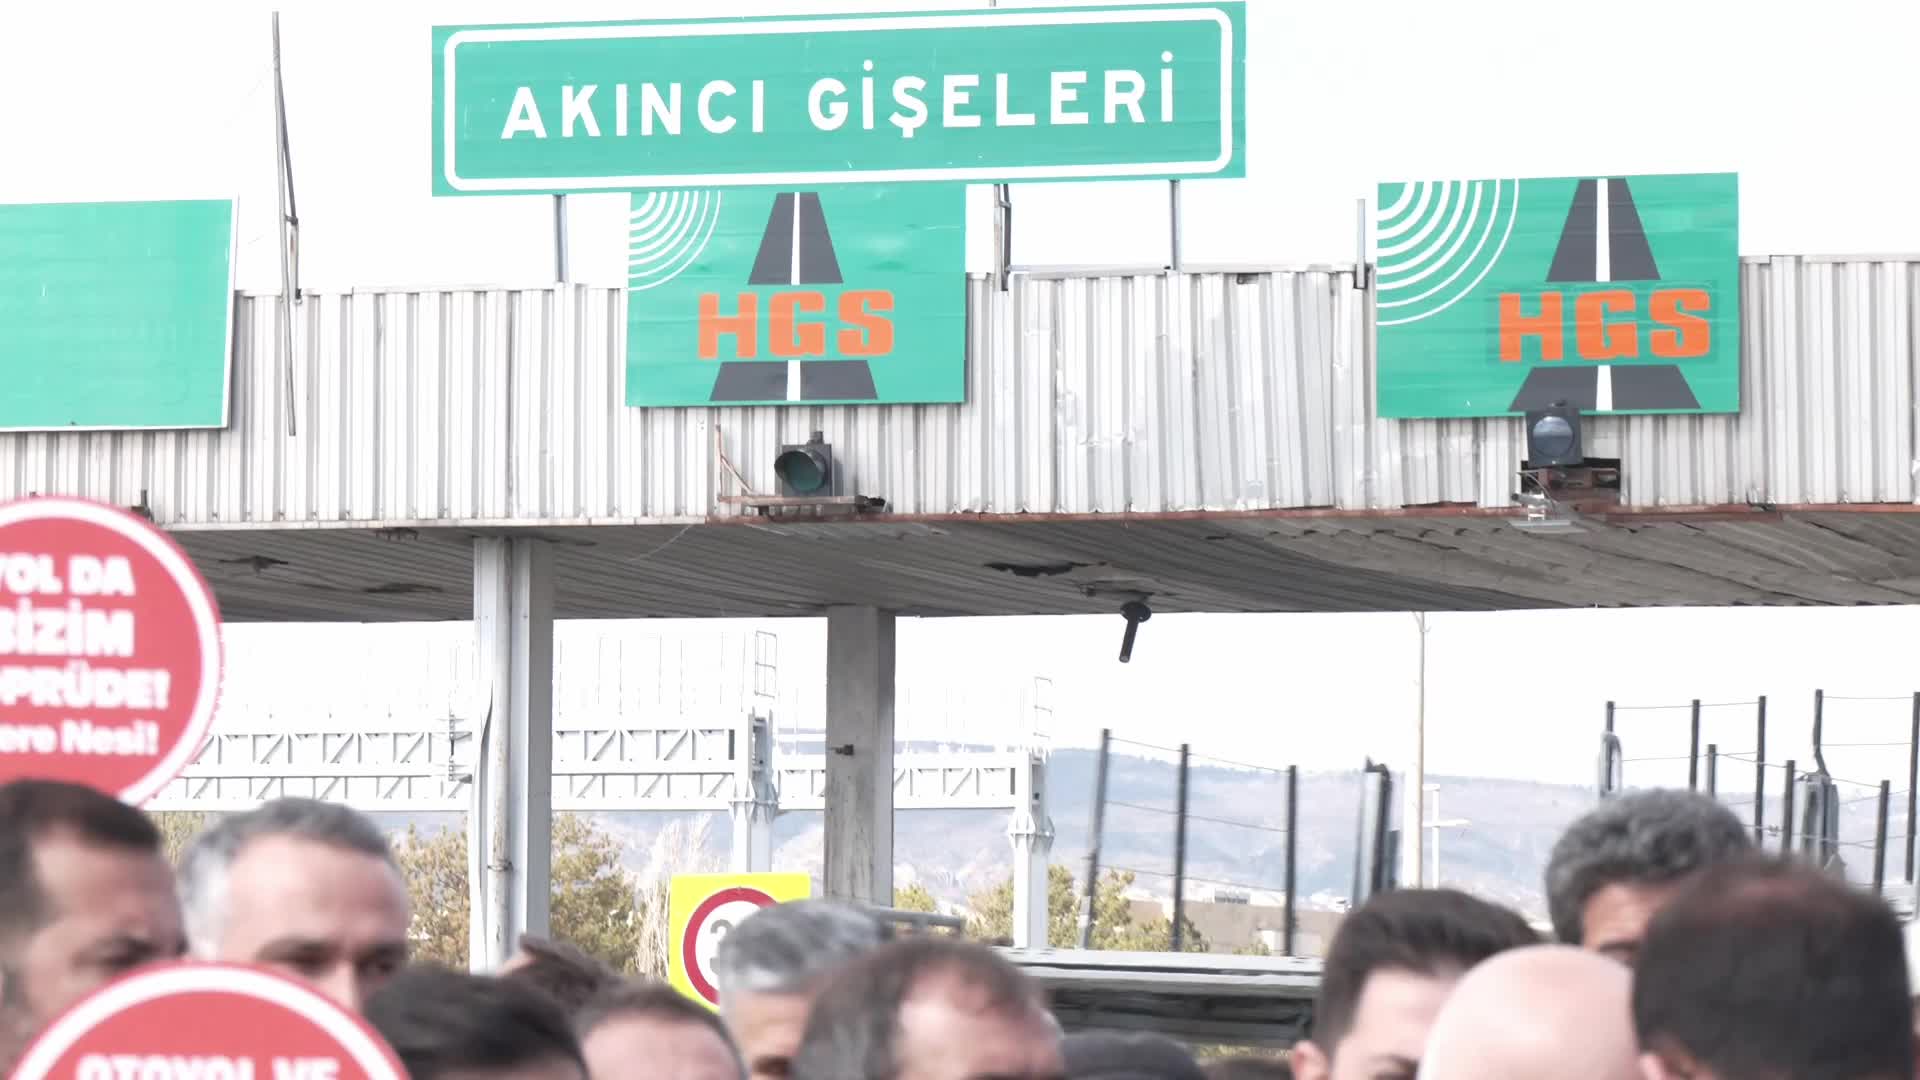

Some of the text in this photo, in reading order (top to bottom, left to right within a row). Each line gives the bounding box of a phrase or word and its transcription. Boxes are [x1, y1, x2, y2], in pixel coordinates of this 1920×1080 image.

[501, 50, 1175, 140] AKINCI GİŞELERİ
[696, 289, 895, 359] HGS
[1498, 288, 1711, 361] HGS
[0, 556, 135, 595] OL DA
[0, 663, 169, 708] PRÜDE!
[63, 721, 158, 754] Nesi!
